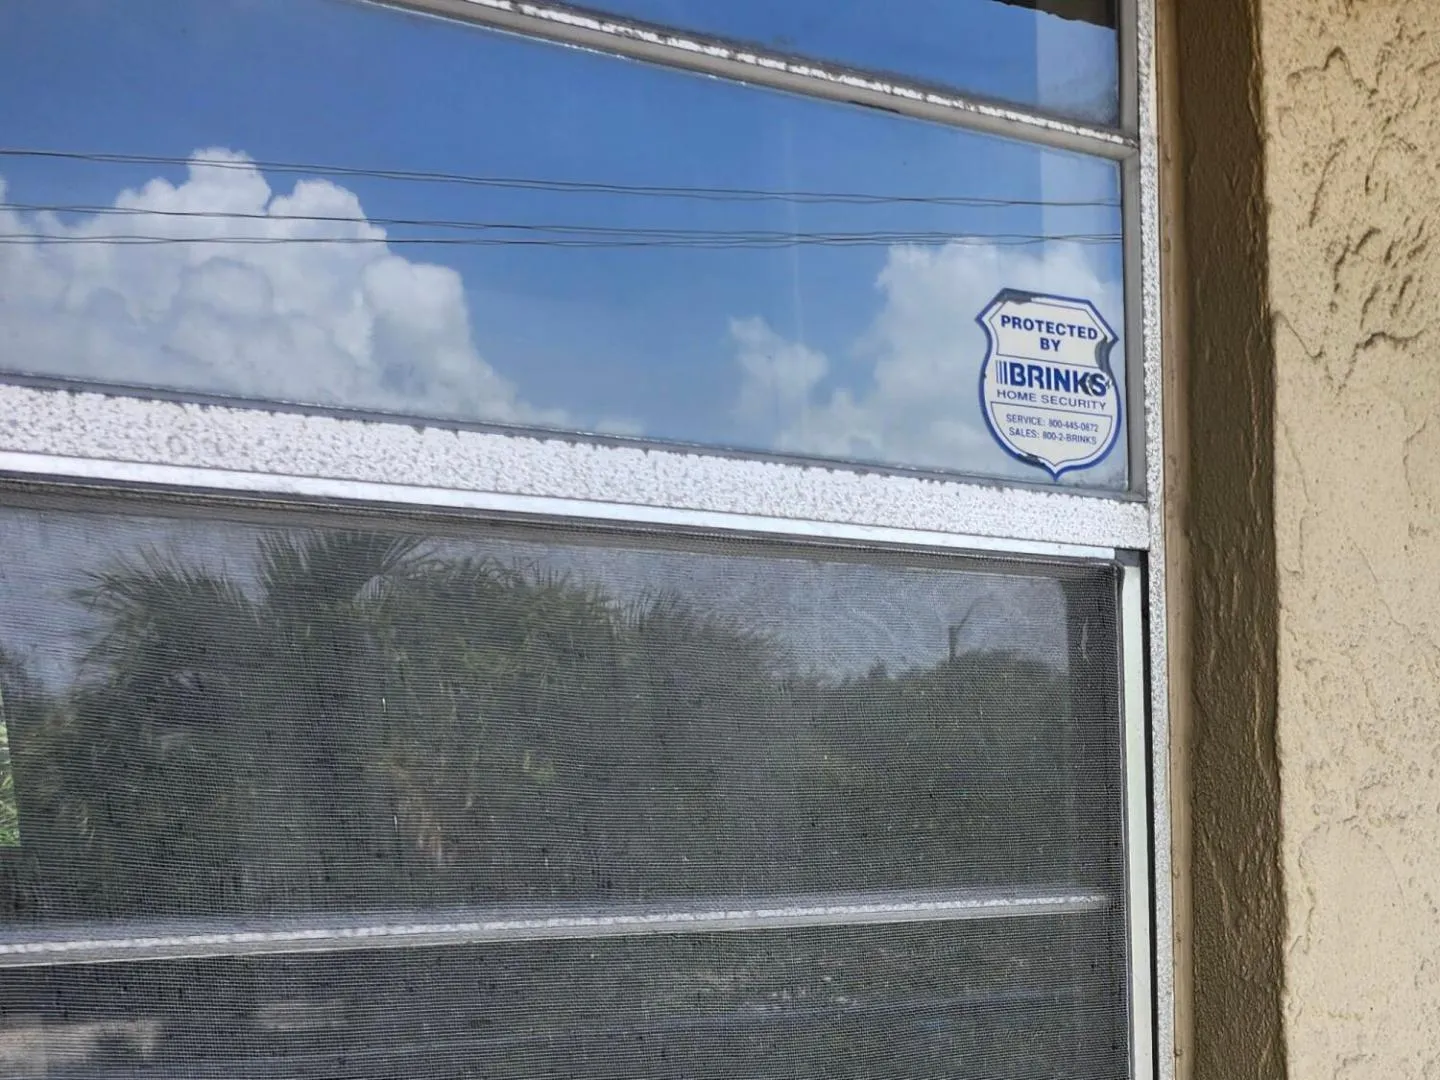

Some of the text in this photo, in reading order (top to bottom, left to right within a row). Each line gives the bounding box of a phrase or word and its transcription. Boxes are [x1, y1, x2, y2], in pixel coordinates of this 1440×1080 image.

[1000, 314, 1098, 340] PROTECTED
[1039, 337, 1061, 352] BY
[1009, 361, 1107, 397] BRINKS
[996, 389, 1107, 411] HOME SECURITY
[1005, 413, 1046, 427] SERVICE:
[1009, 427, 1041, 440] SALES:
